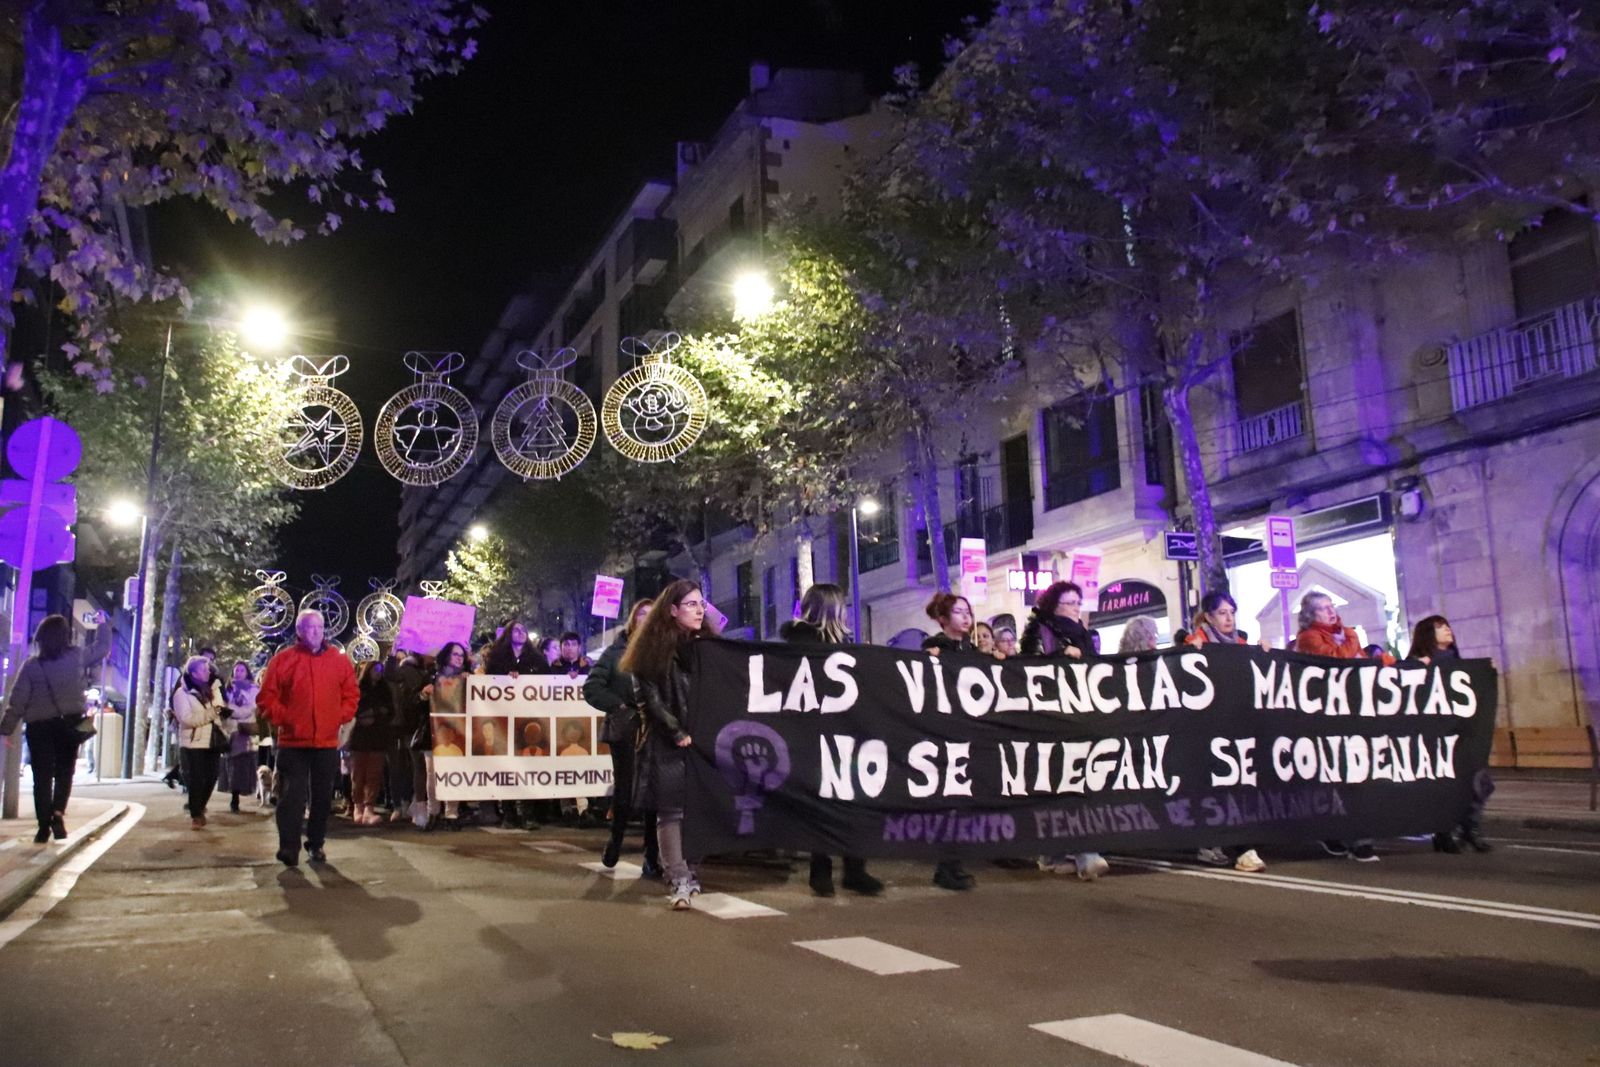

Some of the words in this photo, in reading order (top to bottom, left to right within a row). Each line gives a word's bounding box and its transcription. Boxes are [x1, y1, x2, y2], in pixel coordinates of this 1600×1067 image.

[471, 685, 515, 702] NOS
[747, 652, 858, 714] LAS
[896, 653, 1214, 717] VIOLENCIAS
[1250, 658, 1477, 717] MACHISTAS
[435, 771, 551, 787] MOVIMIENTO
[819, 735, 888, 800] NO
[908, 741, 972, 797] SE
[999, 735, 1181, 796] NIEGAN,
[1211, 737, 1256, 787] SE
[1273, 734, 1458, 783] CONDENAN
[1033, 803, 1160, 839] FEMINISTA
